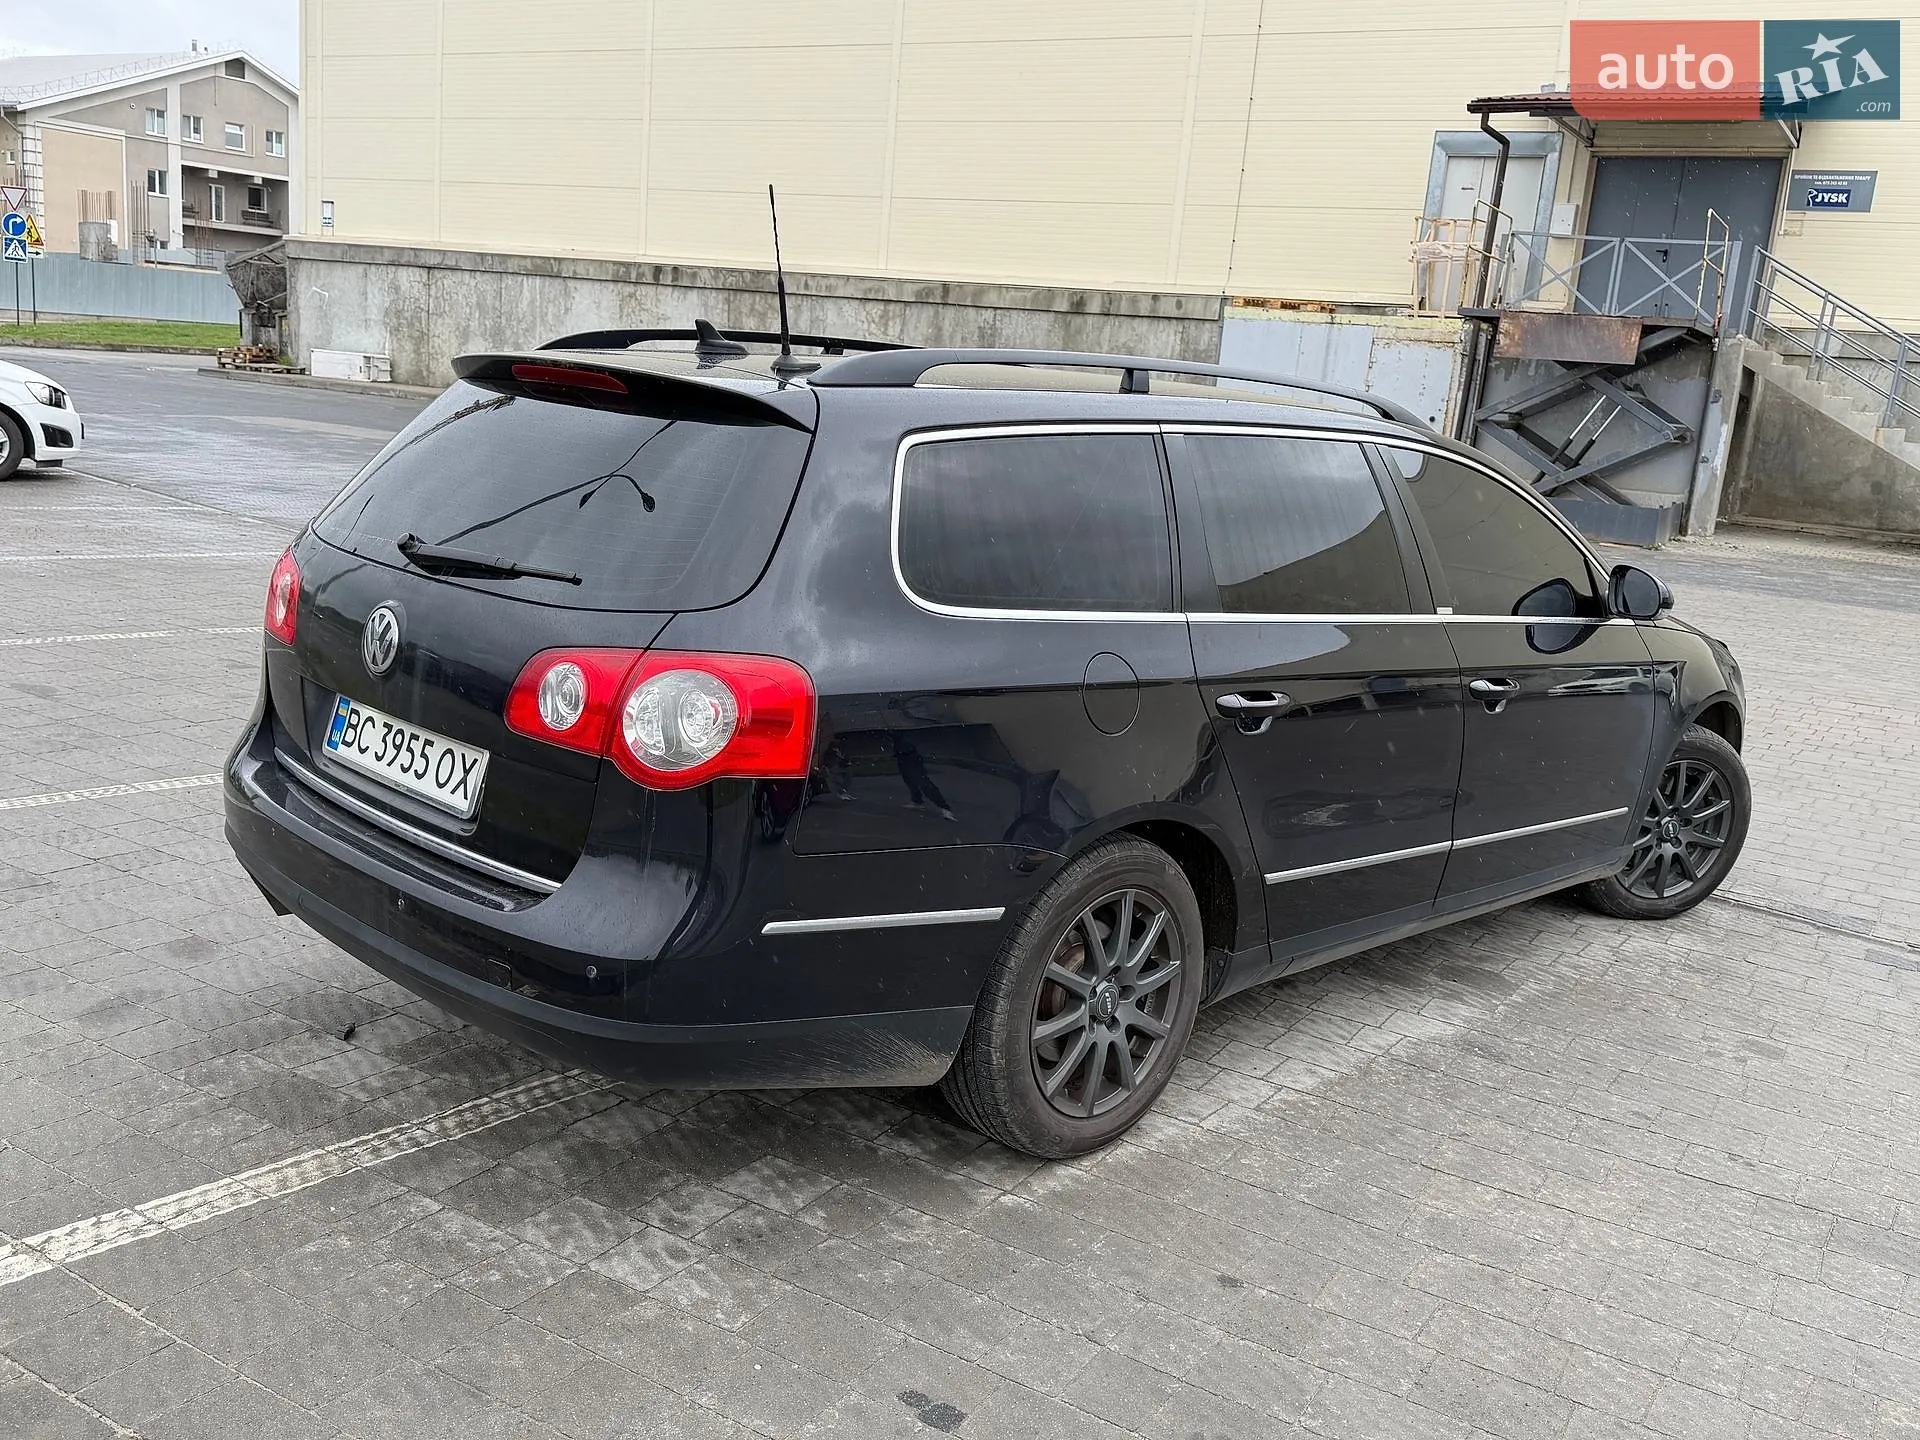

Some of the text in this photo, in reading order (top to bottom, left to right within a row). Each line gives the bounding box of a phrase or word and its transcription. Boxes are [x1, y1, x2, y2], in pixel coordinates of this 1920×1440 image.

[1815, 192, 1849, 203] JYSK
[331, 729, 341, 742] UA
[341, 707, 479, 801] BC 3955 OX
